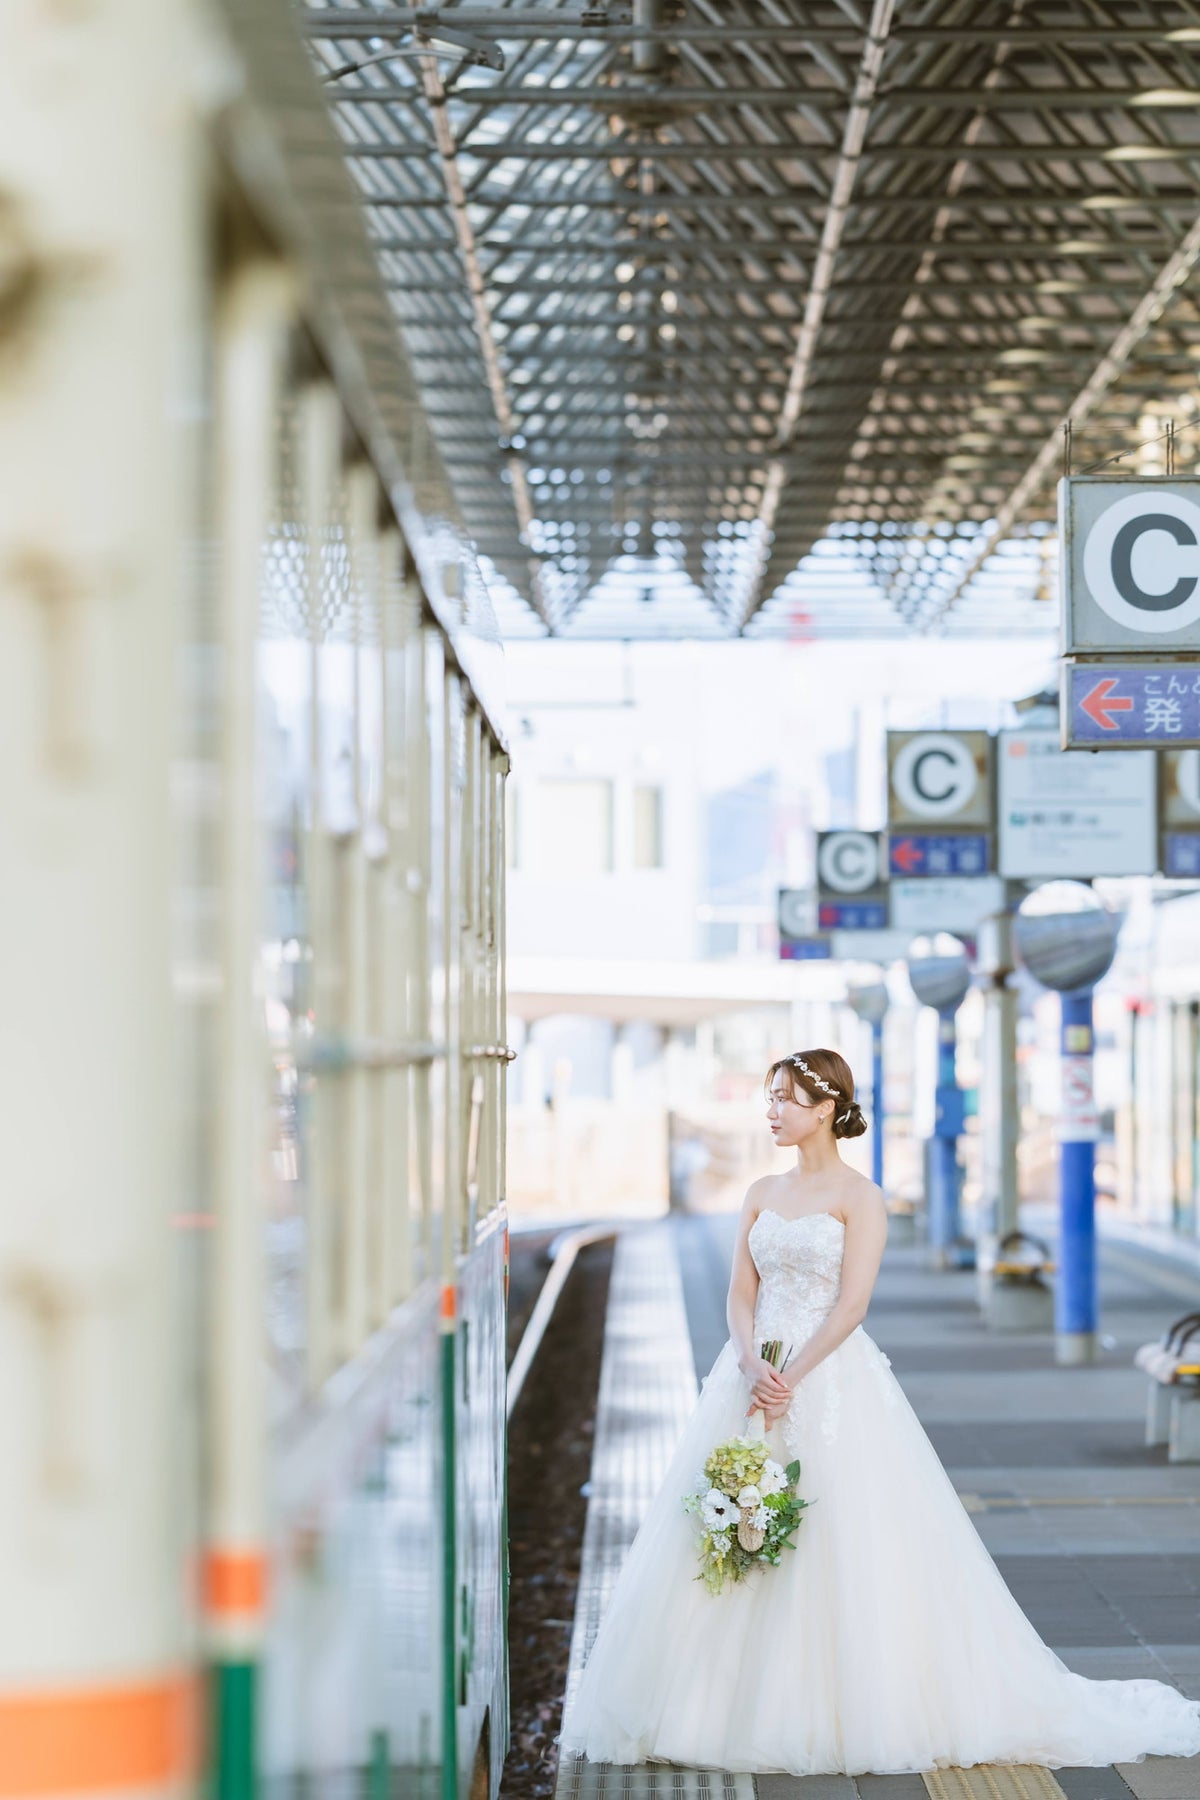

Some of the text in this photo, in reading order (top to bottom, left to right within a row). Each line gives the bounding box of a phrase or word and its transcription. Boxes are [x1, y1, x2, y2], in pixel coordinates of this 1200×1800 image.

[1110, 513, 1199, 612] C
[911, 749, 957, 802] C
[832, 841, 866, 881] C
